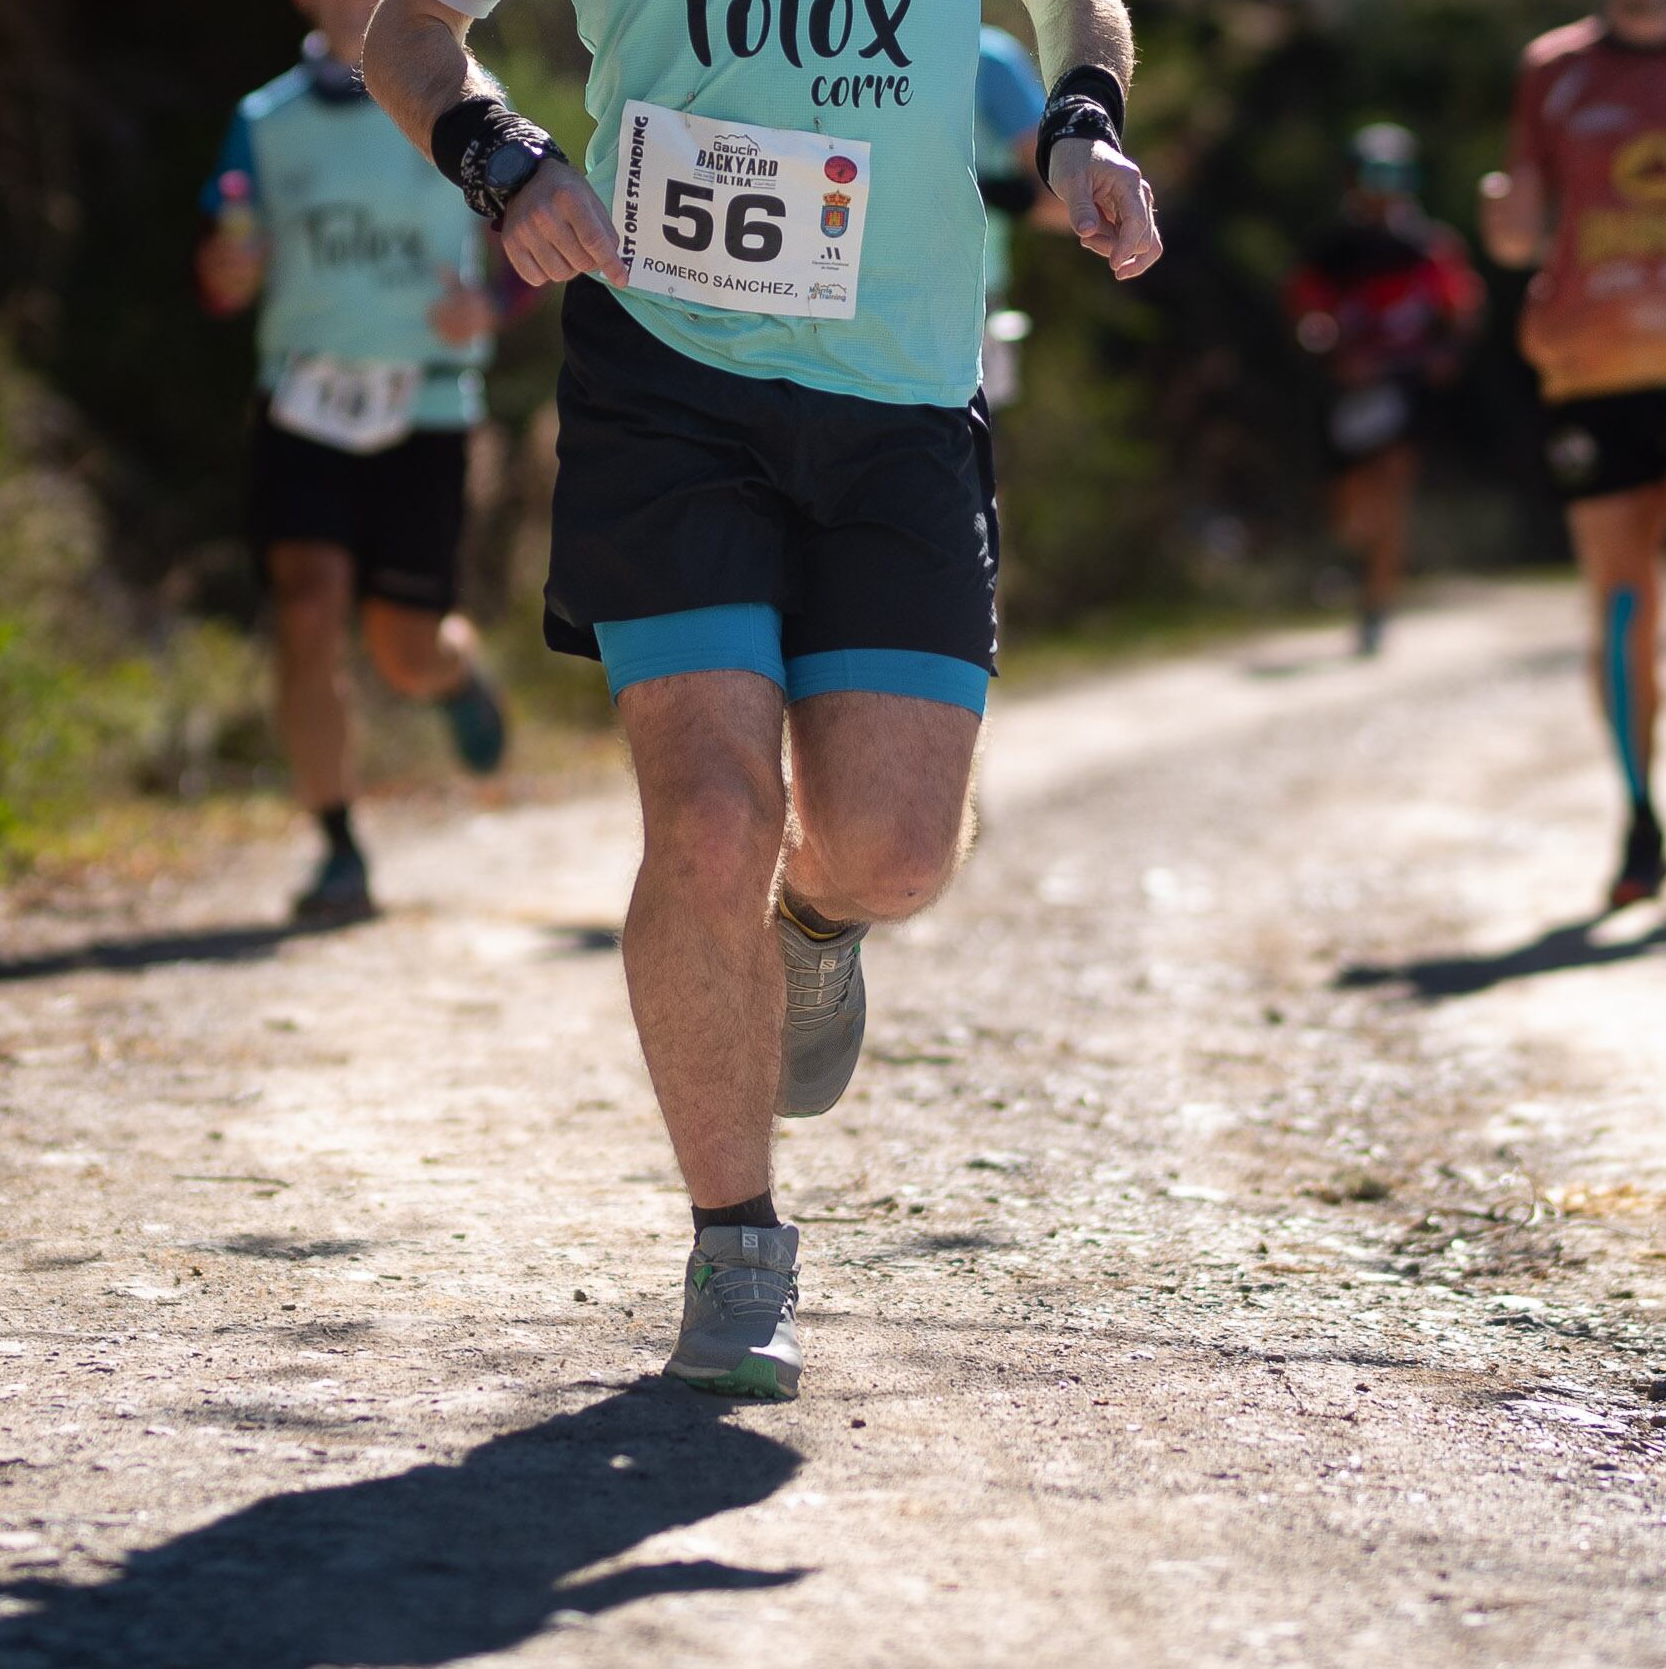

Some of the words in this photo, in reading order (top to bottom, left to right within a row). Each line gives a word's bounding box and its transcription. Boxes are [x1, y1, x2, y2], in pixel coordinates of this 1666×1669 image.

[811, 75, 913, 108] corre
[626, 115, 649, 199] STANDING
[696, 150, 778, 177] BACKYARD
[714, 141, 758, 156] Gaucín
[716, 174, 752, 187] ULTRA
[625, 201, 639, 233] ONE
[662, 178, 787, 263] 56
[643, 257, 709, 284] ROMERO
[713, 274, 799, 298] SÁNCHEZ,
